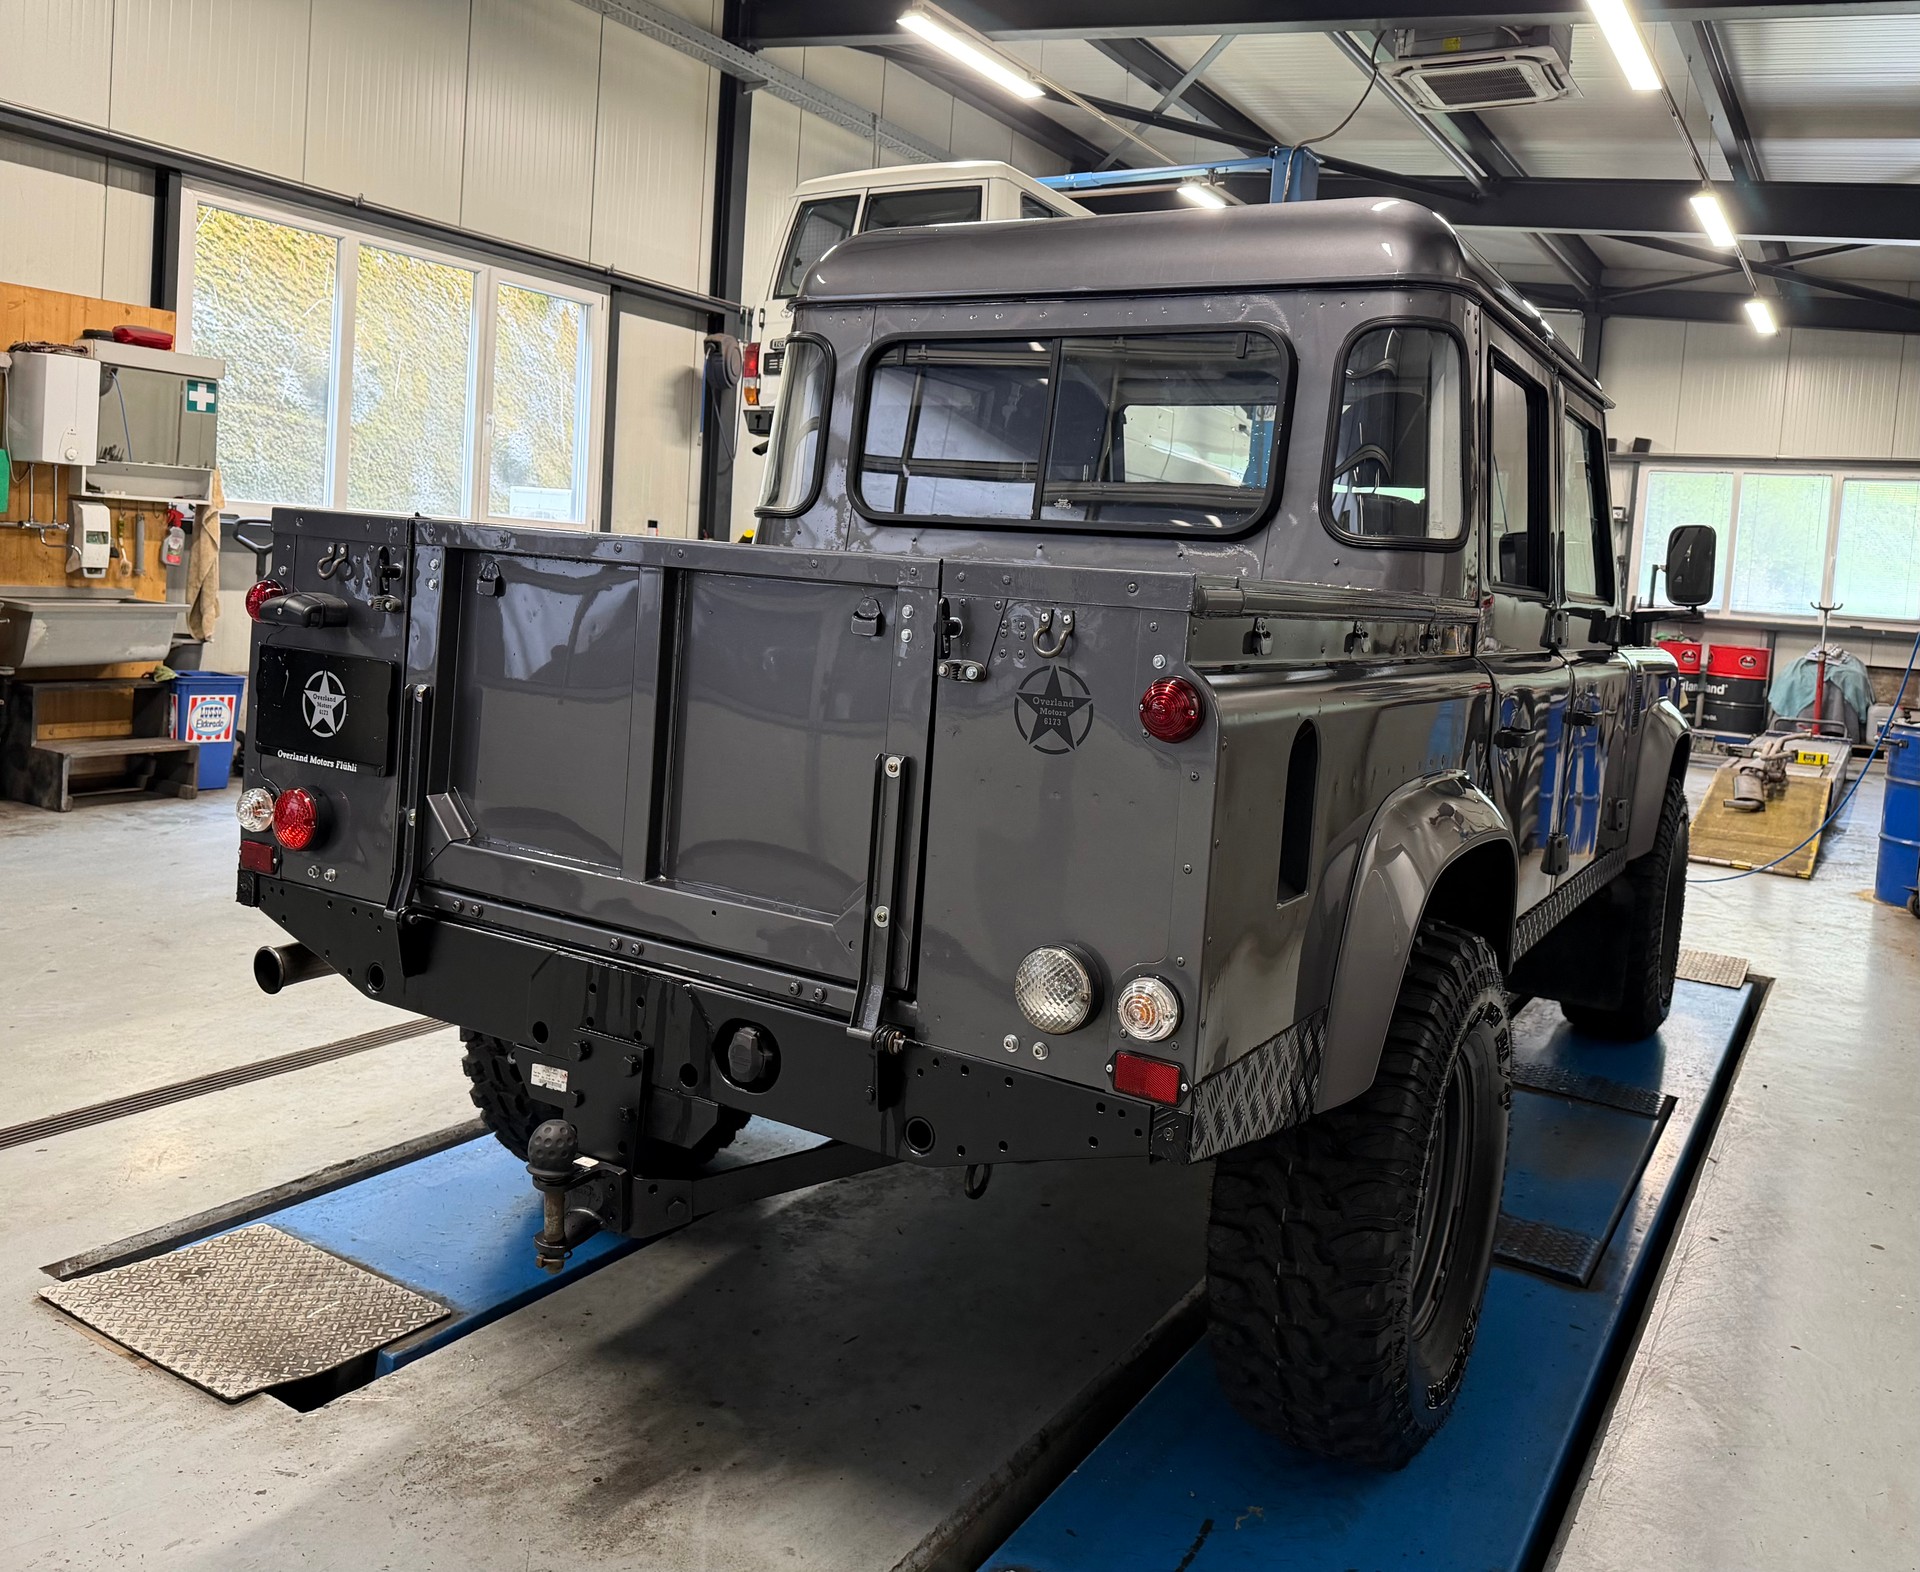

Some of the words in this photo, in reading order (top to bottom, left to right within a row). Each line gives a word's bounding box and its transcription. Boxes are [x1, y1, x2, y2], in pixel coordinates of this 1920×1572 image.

[313, 693, 337, 703] Overland
[1033, 697, 1074, 708] Overland
[200, 706, 223, 718] LUSSO
[1039, 708, 1067, 716] Motors
[196, 719, 224, 729] Eldorado
[1043, 718, 1061, 726] 6173
[277, 749, 309, 763] Overland
[309, 755, 335, 768] Motors
[335, 760, 358, 773] Flühli
